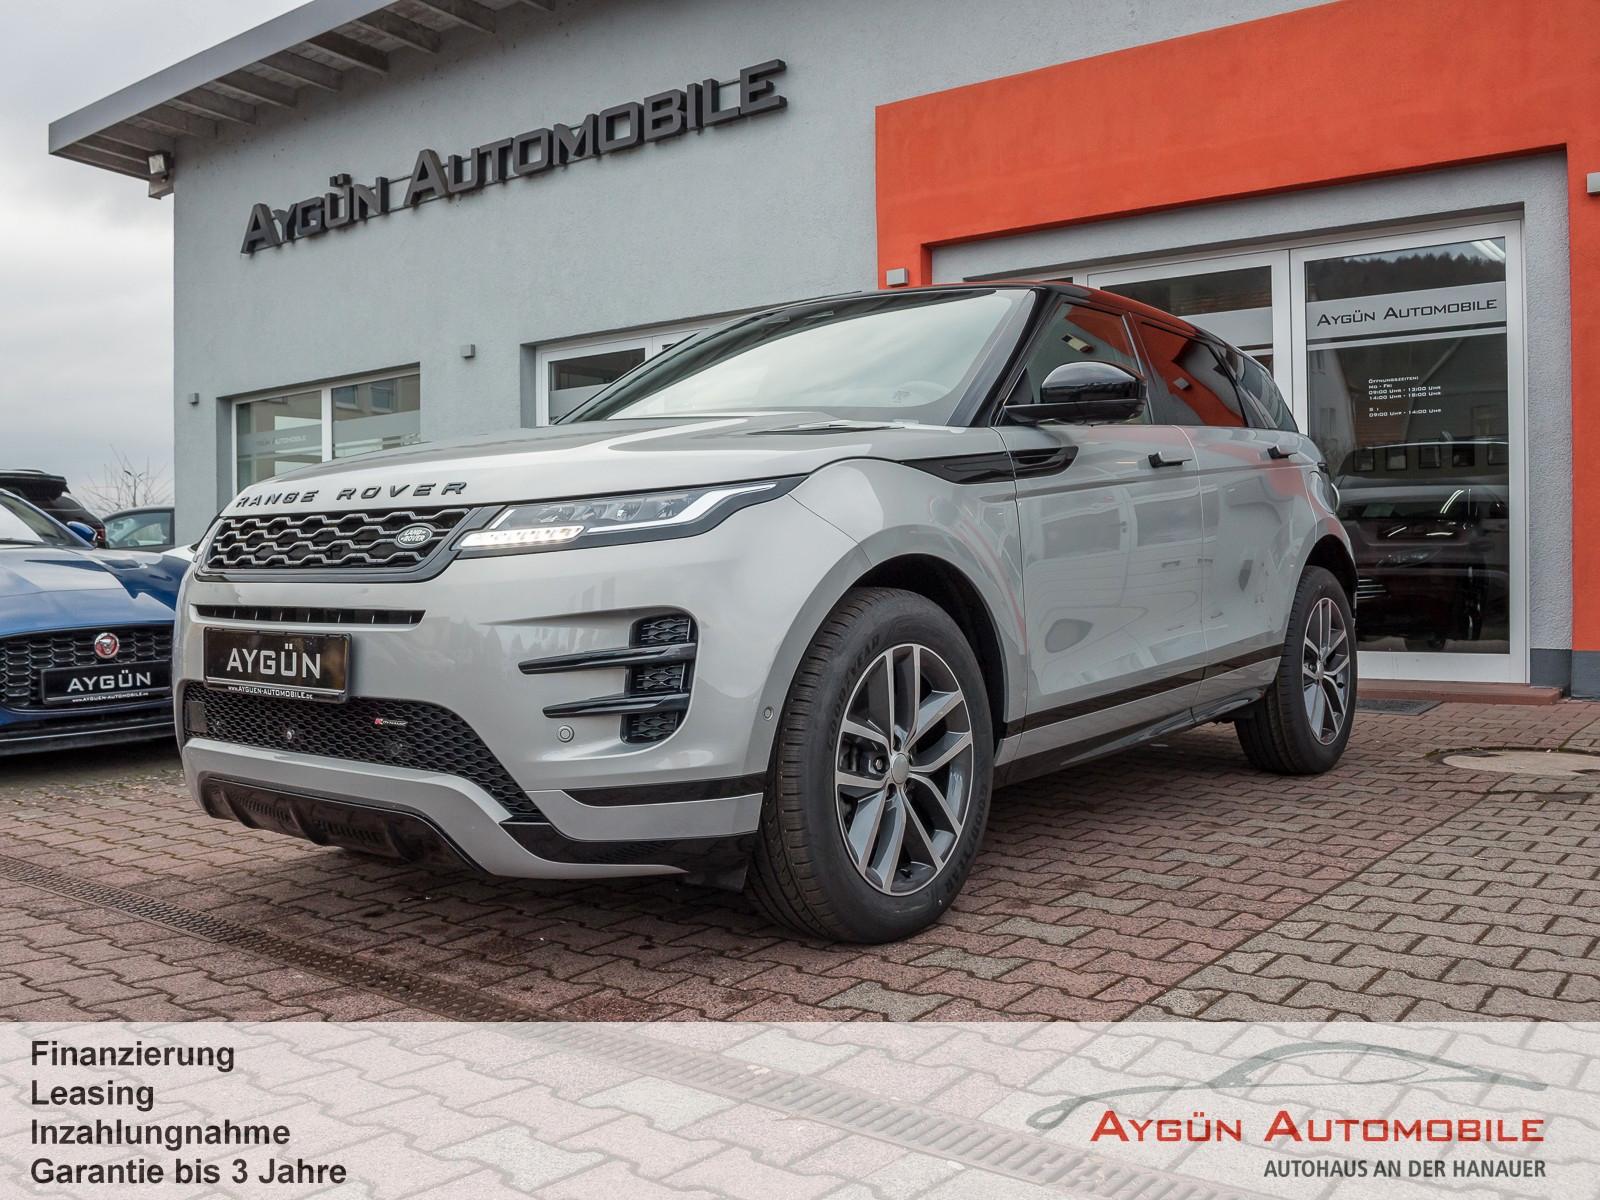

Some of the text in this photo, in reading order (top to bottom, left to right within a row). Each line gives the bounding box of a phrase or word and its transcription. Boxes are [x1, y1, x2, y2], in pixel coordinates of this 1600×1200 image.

[241, 58, 788, 254] AYGÜN AUTOMOBILE
[1317, 298, 1497, 327] AYGÜN AUTOMOBILE
[235, 481, 467, 508] RANGE ROVER
[226, 643, 321, 679] AYGÜN
[67, 669, 152, 692] AYGÜN
